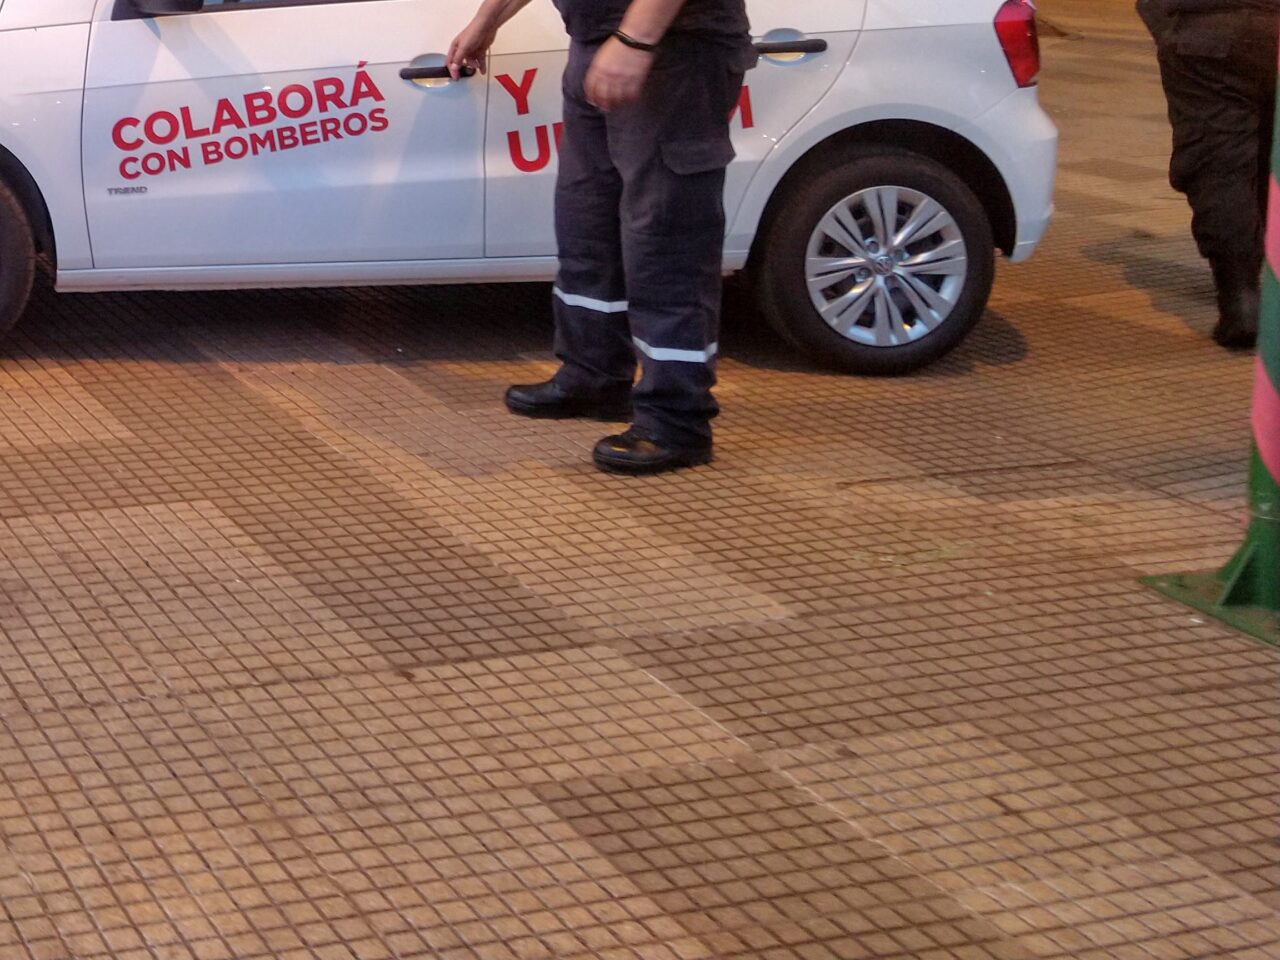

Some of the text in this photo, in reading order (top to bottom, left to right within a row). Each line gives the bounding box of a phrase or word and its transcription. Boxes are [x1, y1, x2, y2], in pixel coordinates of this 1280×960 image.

[111, 60, 538, 152] COLABORÁ Y
[118, 107, 390, 180] CON BOMBEROS
